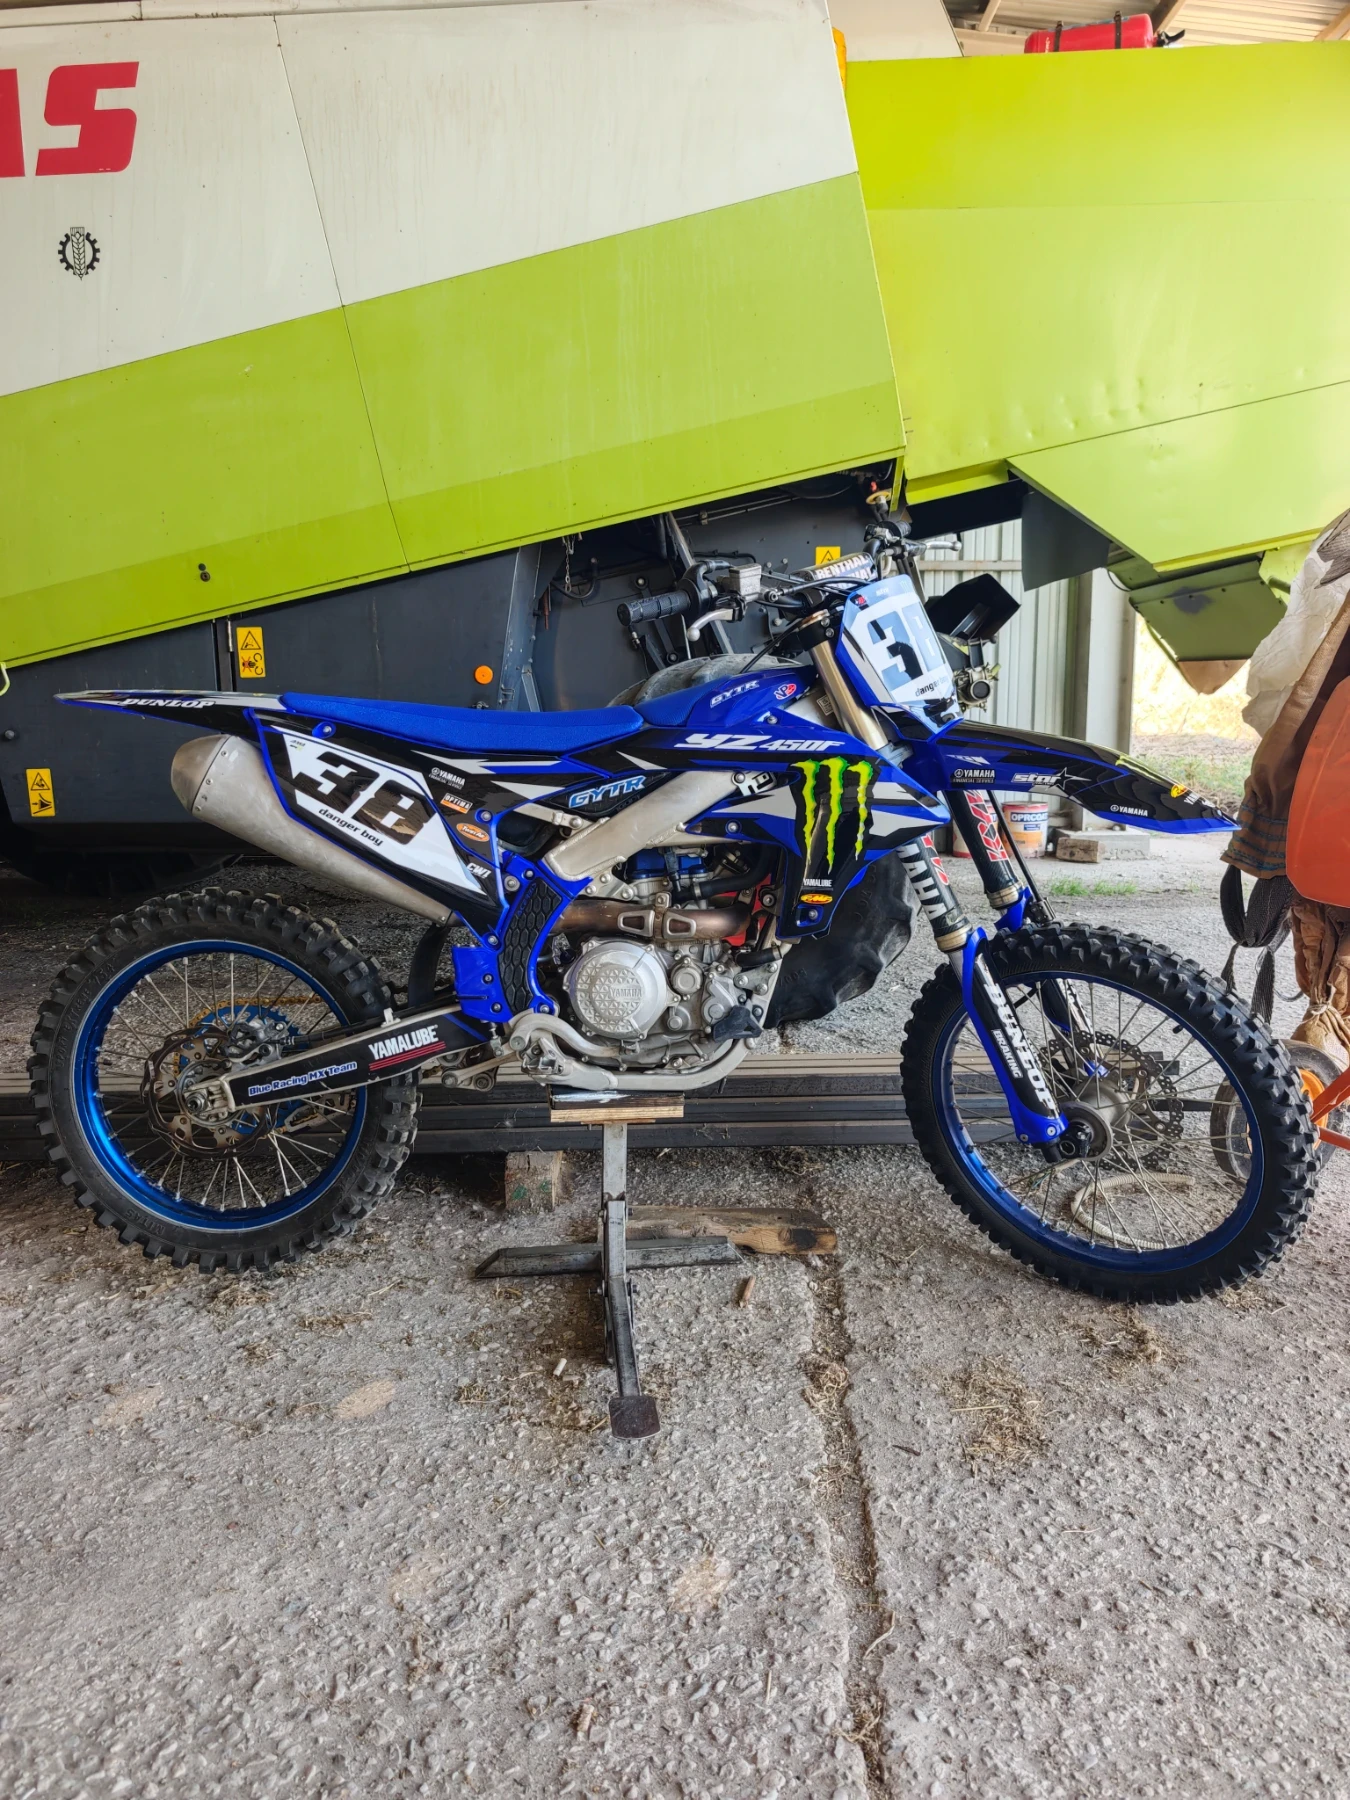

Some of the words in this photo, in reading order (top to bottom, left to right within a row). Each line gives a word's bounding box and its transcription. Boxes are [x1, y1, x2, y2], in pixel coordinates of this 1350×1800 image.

[815, 554, 870, 581] RENTHAL
[120, 698, 215, 709] DUNLOP
[710, 680, 760, 709] GYTR
[440, 769, 466, 787] YAMAHA
[964, 769, 996, 778] YAMAHA
[293, 751, 433, 845] 38
[444, 793, 473, 811] OPTIMA
[569, 775, 647, 808] GYTR
[1119, 805, 1149, 817] YAMAHA
[318, 807, 363, 834] danger
[360, 829, 384, 847] boy
[803, 878, 833, 888] YAMALUBE
[610, 986, 643, 998] YAMAHA
[368, 1025, 439, 1060] YAMALUBE
[983, 982, 1059, 1110] DUNLOP
[991, 1028, 1024, 1079] BRAKING
[248, 1083, 272, 1097] Blue
[272, 1075, 309, 1091] Racing
[309, 1069, 326, 1081] MX
[326, 1061, 358, 1076] Team
